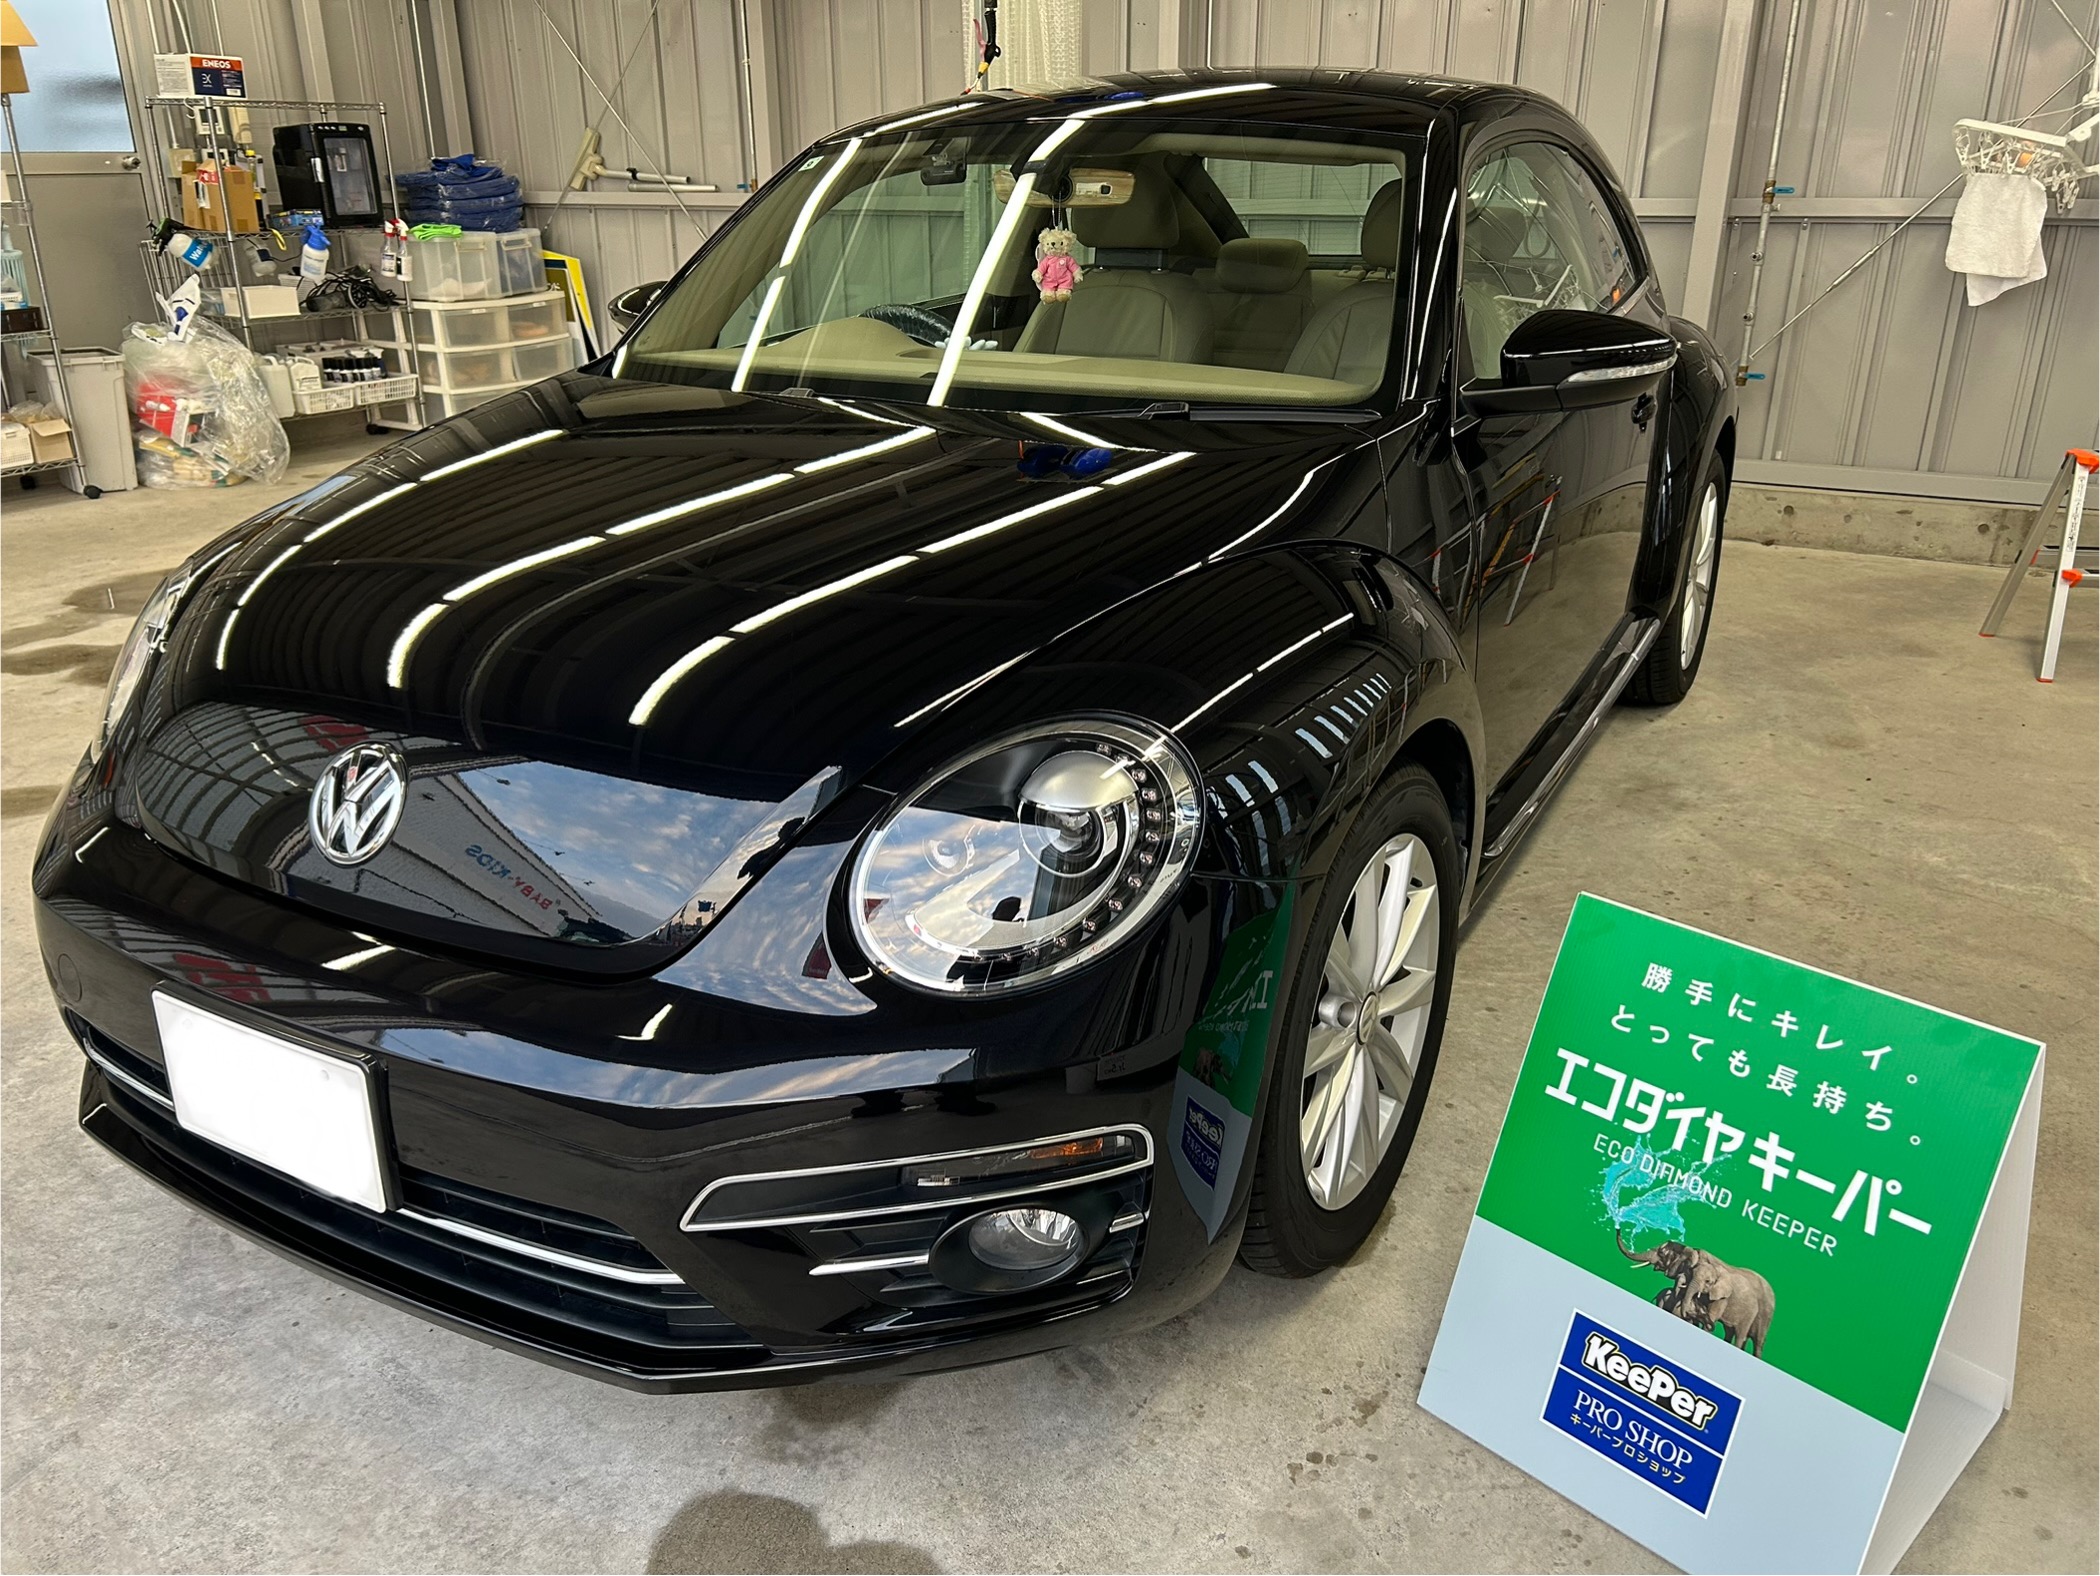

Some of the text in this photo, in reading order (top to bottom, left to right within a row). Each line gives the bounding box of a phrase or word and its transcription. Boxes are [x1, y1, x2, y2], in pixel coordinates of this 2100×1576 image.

[201, 59, 231, 69] ENEOS
[1610, 1004, 1921, 1146] とっても長持ち。
[1641, 962, 1918, 1085] 勝手にキレイ。
[1544, 1047, 1932, 1236] エコダイヤキーパー
[1593, 1133, 1838, 1257] ECO DIAMOND KEEPER
[1573, 1389, 1693, 1470] PRO SHOP
[1582, 1332, 1718, 1429] KeePer
[1570, 1412, 1686, 1484] キーパープロショップ
